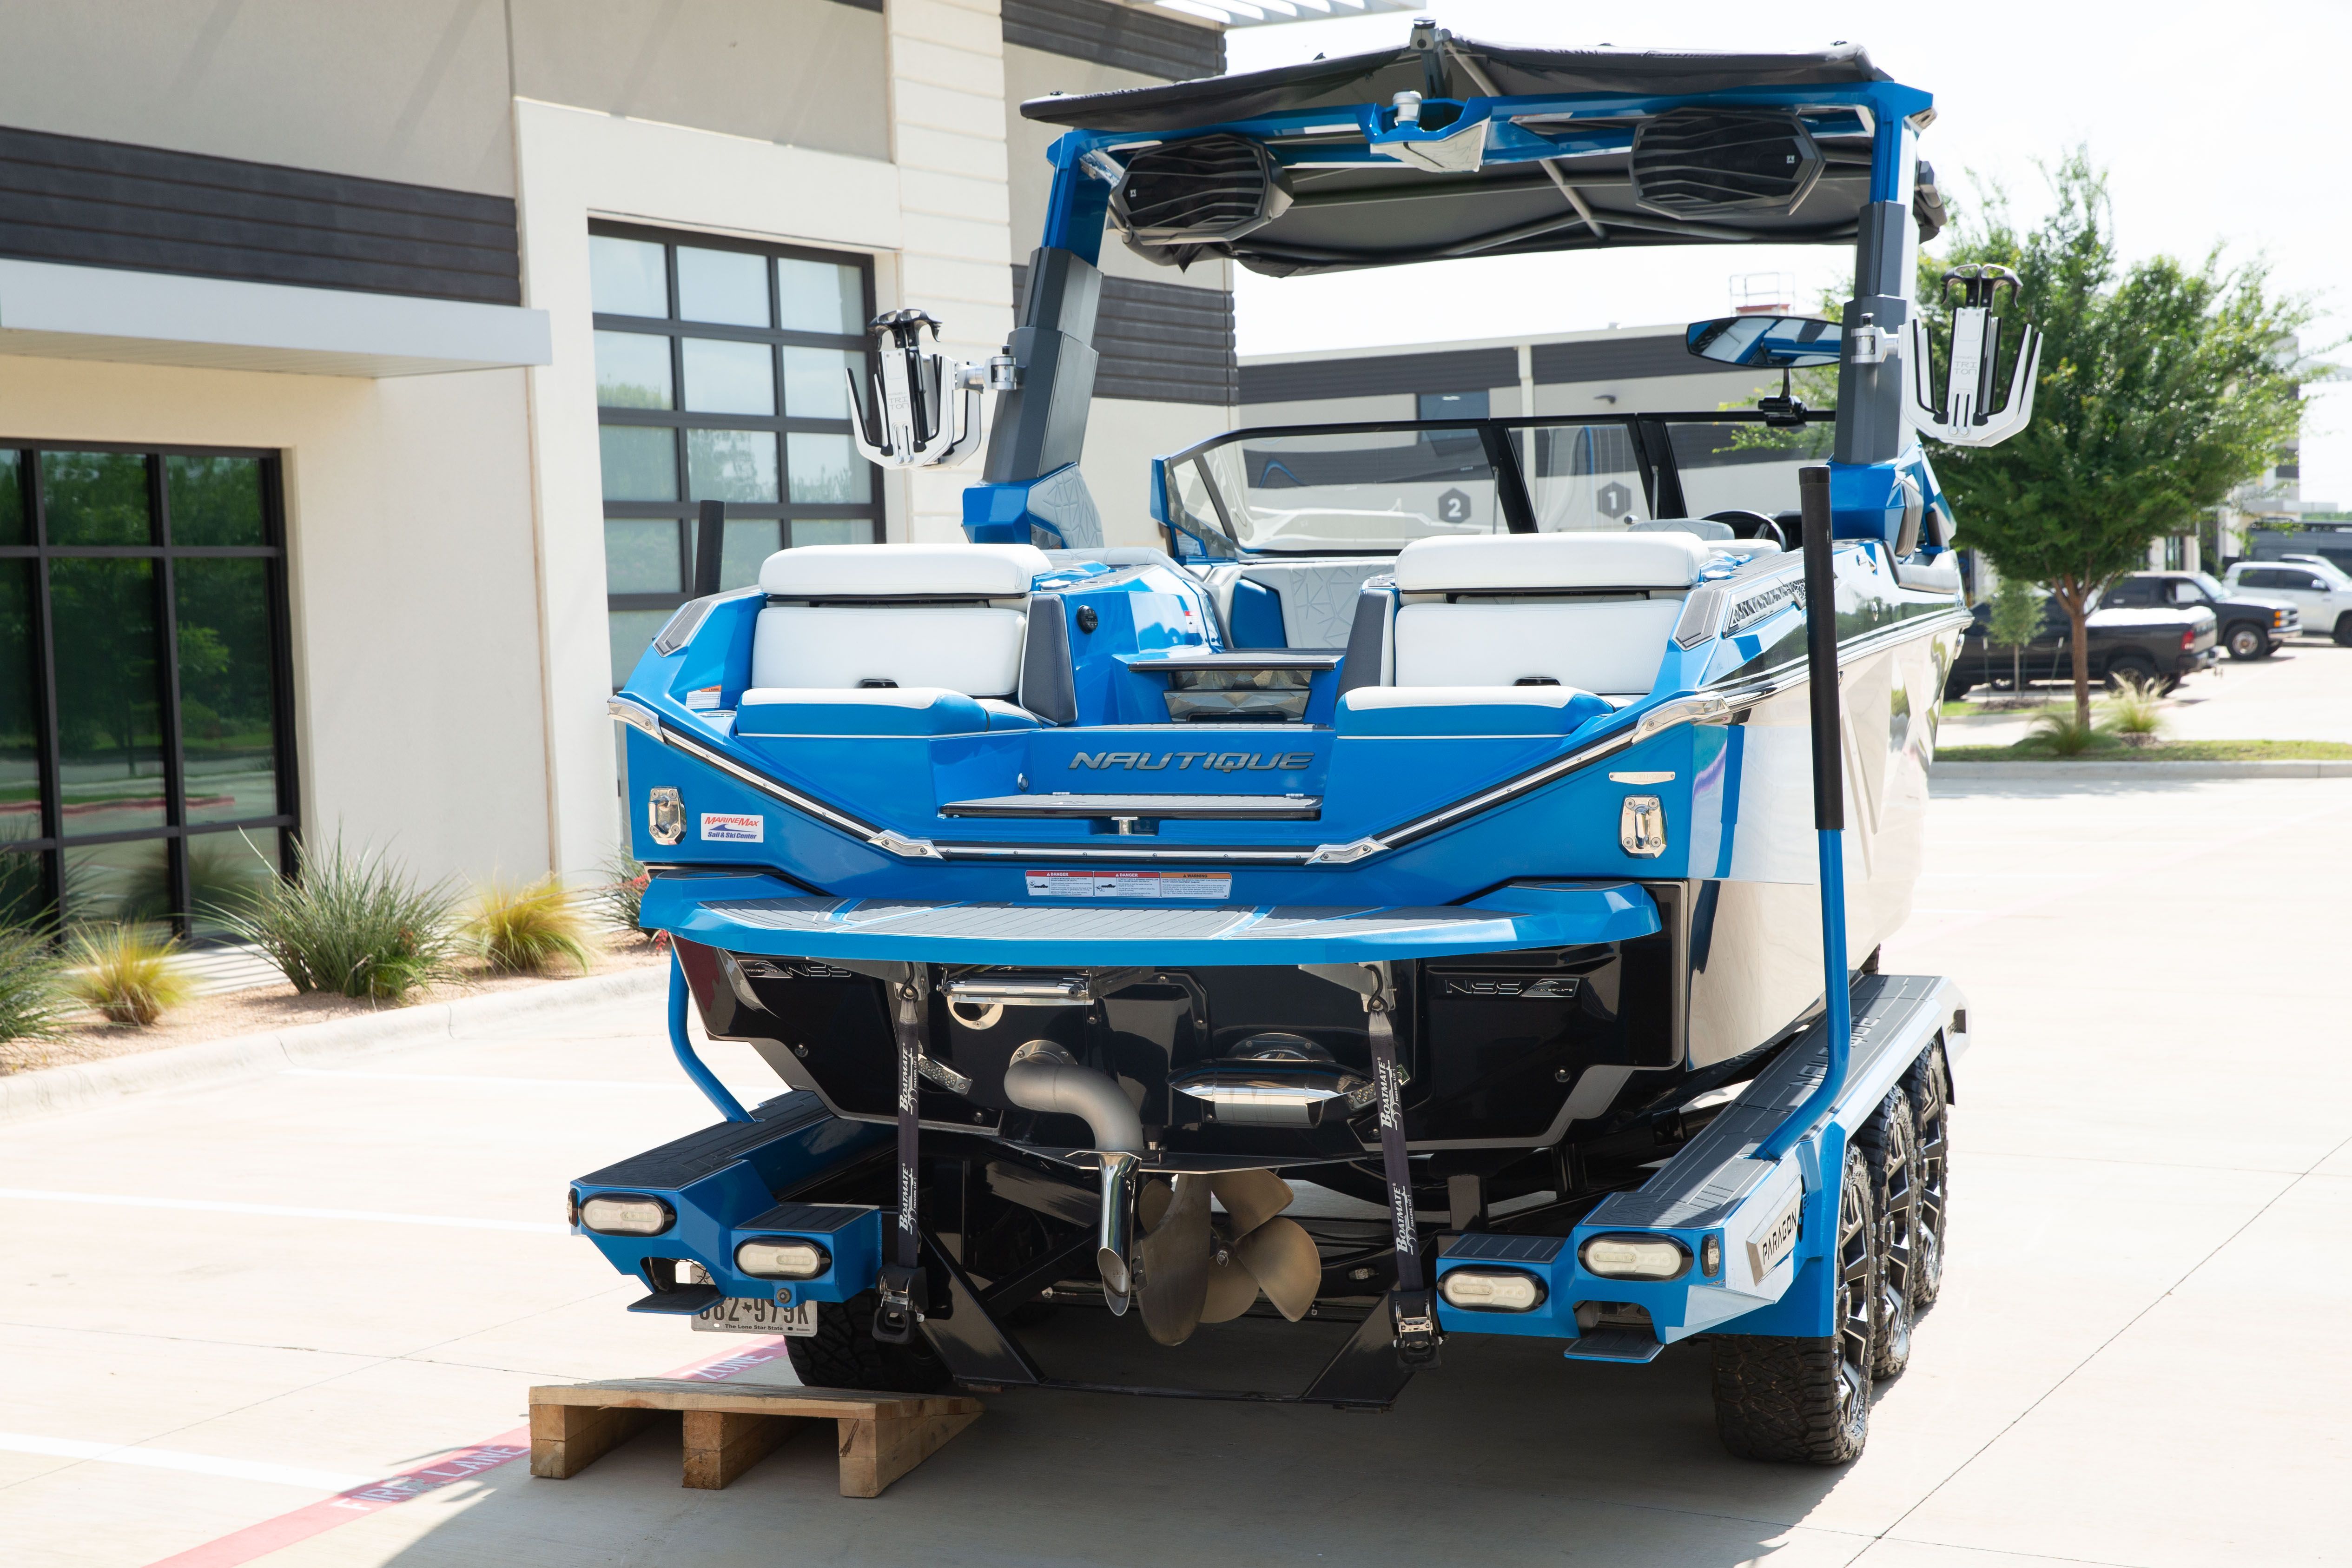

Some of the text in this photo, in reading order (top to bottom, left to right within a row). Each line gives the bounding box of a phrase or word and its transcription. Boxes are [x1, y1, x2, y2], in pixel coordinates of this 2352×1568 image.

[1447, 498, 1461, 518] 2
[1609, 491, 1619, 510] 1
[1069, 752, 1315, 773] NAUTIQUE
[784, 963, 852, 977] NSS
[1445, 979, 1523, 995] NSS
[1763, 1207, 1797, 1265] PARAGON
[422, 1445, 531, 1477] LANE
